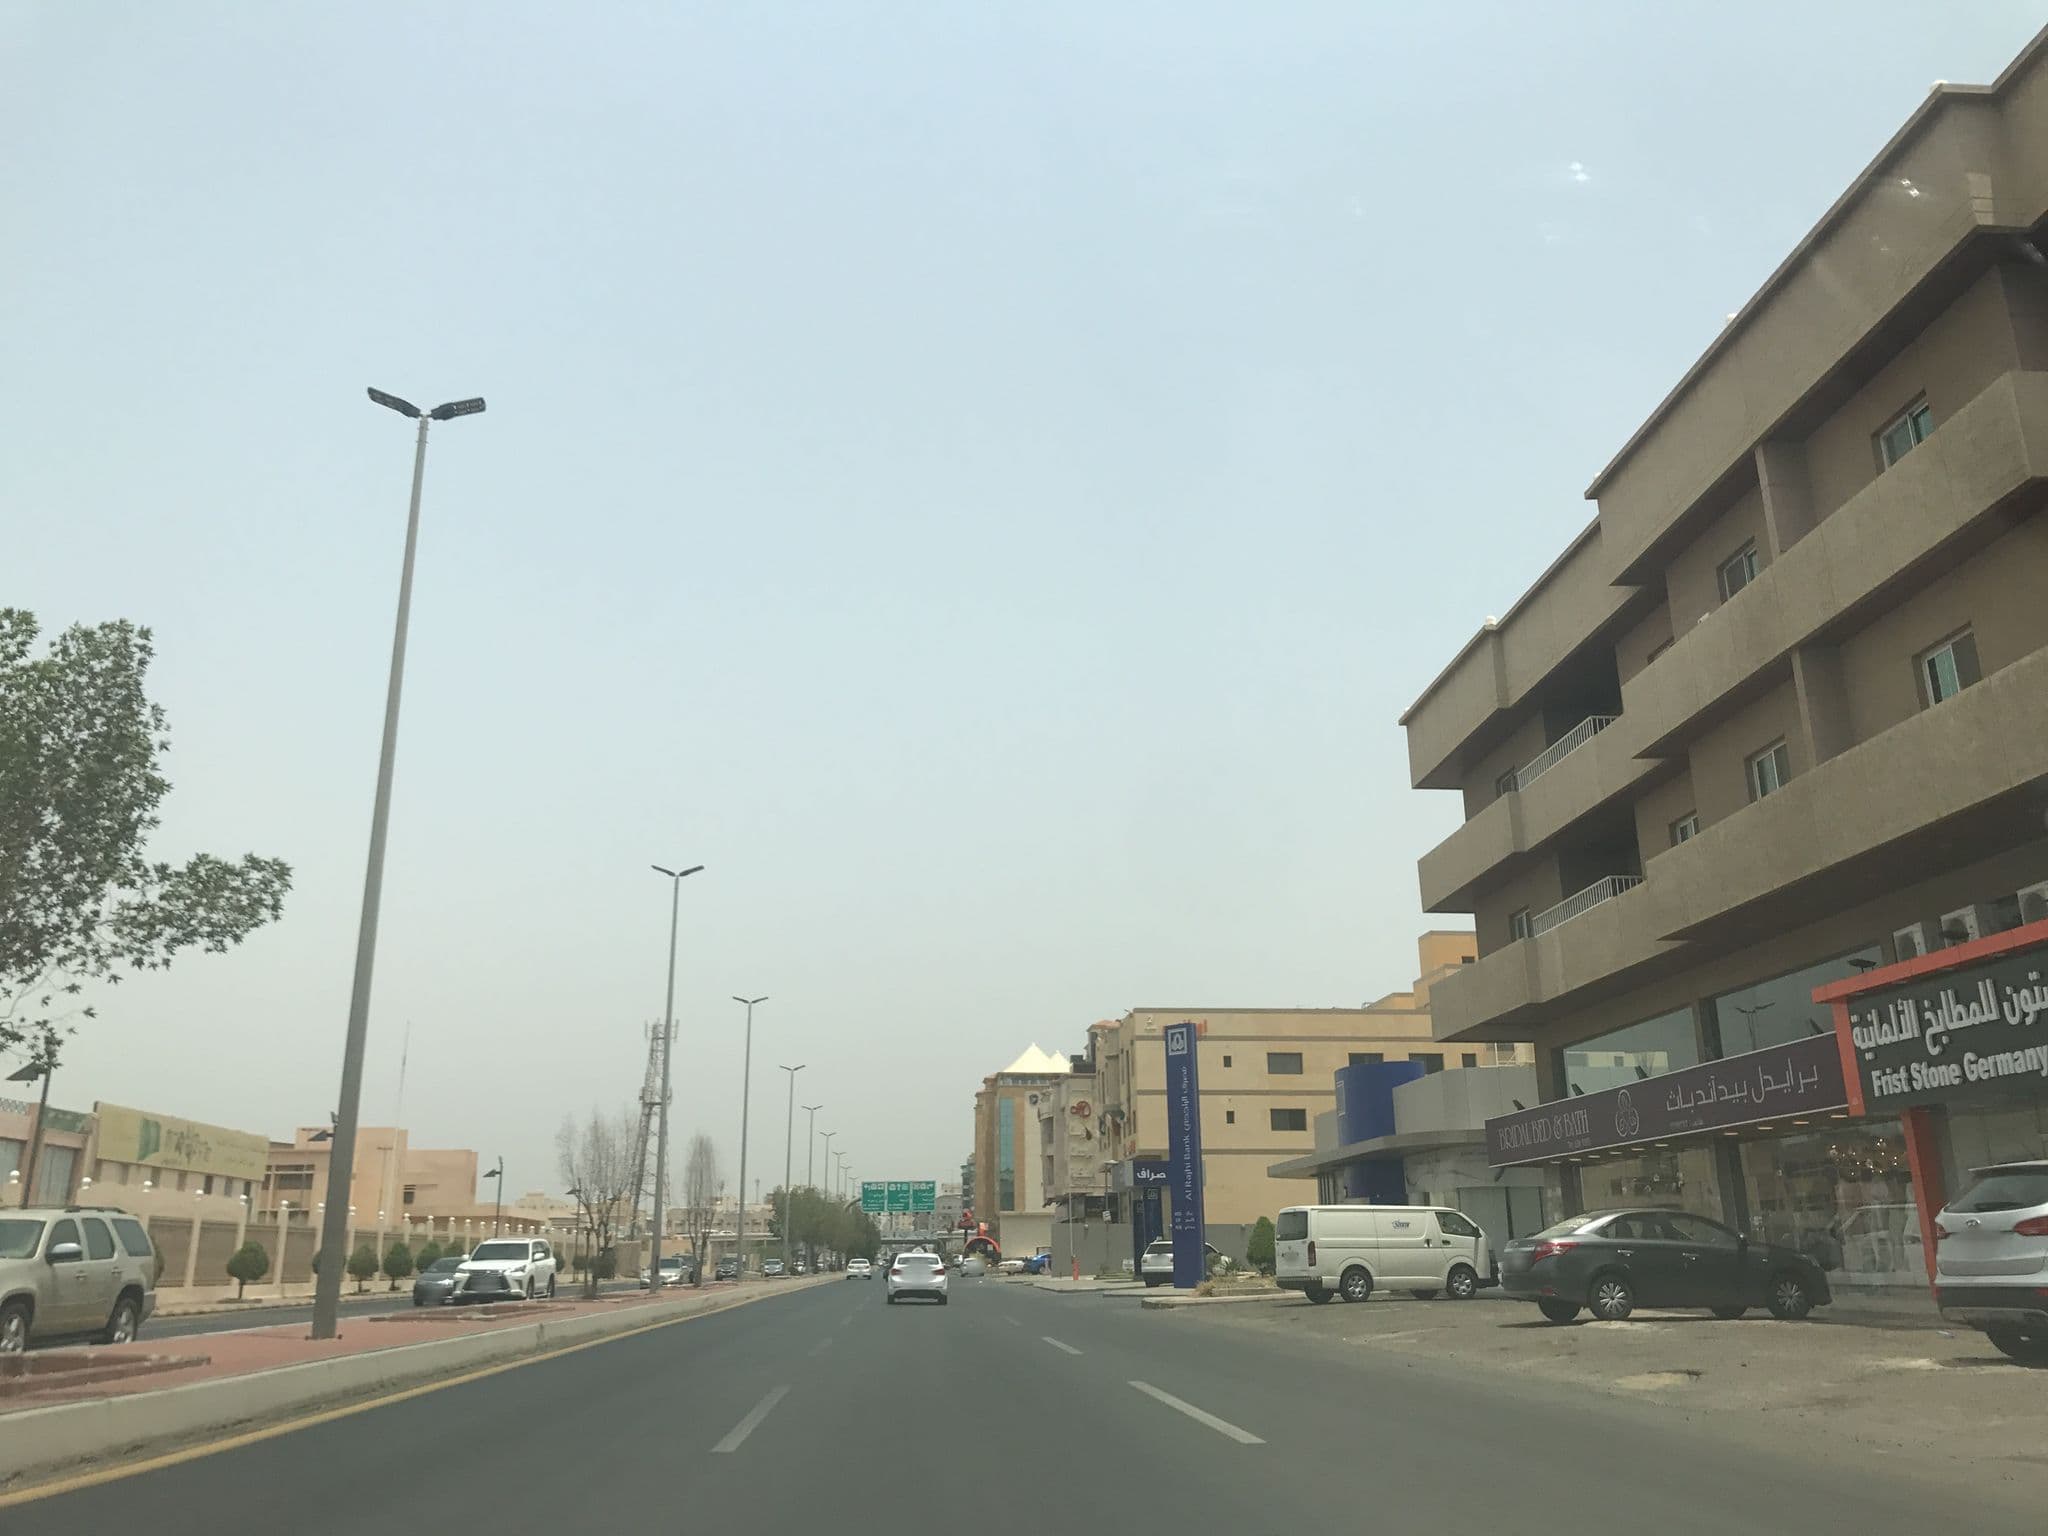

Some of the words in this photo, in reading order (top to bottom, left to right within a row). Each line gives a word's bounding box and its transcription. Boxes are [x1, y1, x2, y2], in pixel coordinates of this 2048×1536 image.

[1851, 998, 1920, 1061] الألمانية
[1925, 978, 2000, 1056] للمطابخ
[1871, 1065, 1910, 1097] Frist
[1910, 1060, 1963, 1091] Stone
[1963, 1044, 2048, 1081] Germany
[1563, 1108, 1590, 1138] BATH
[1183, 1134, 1192, 1160] Bank
[1137, 1168, 1167, 1181] صراف
